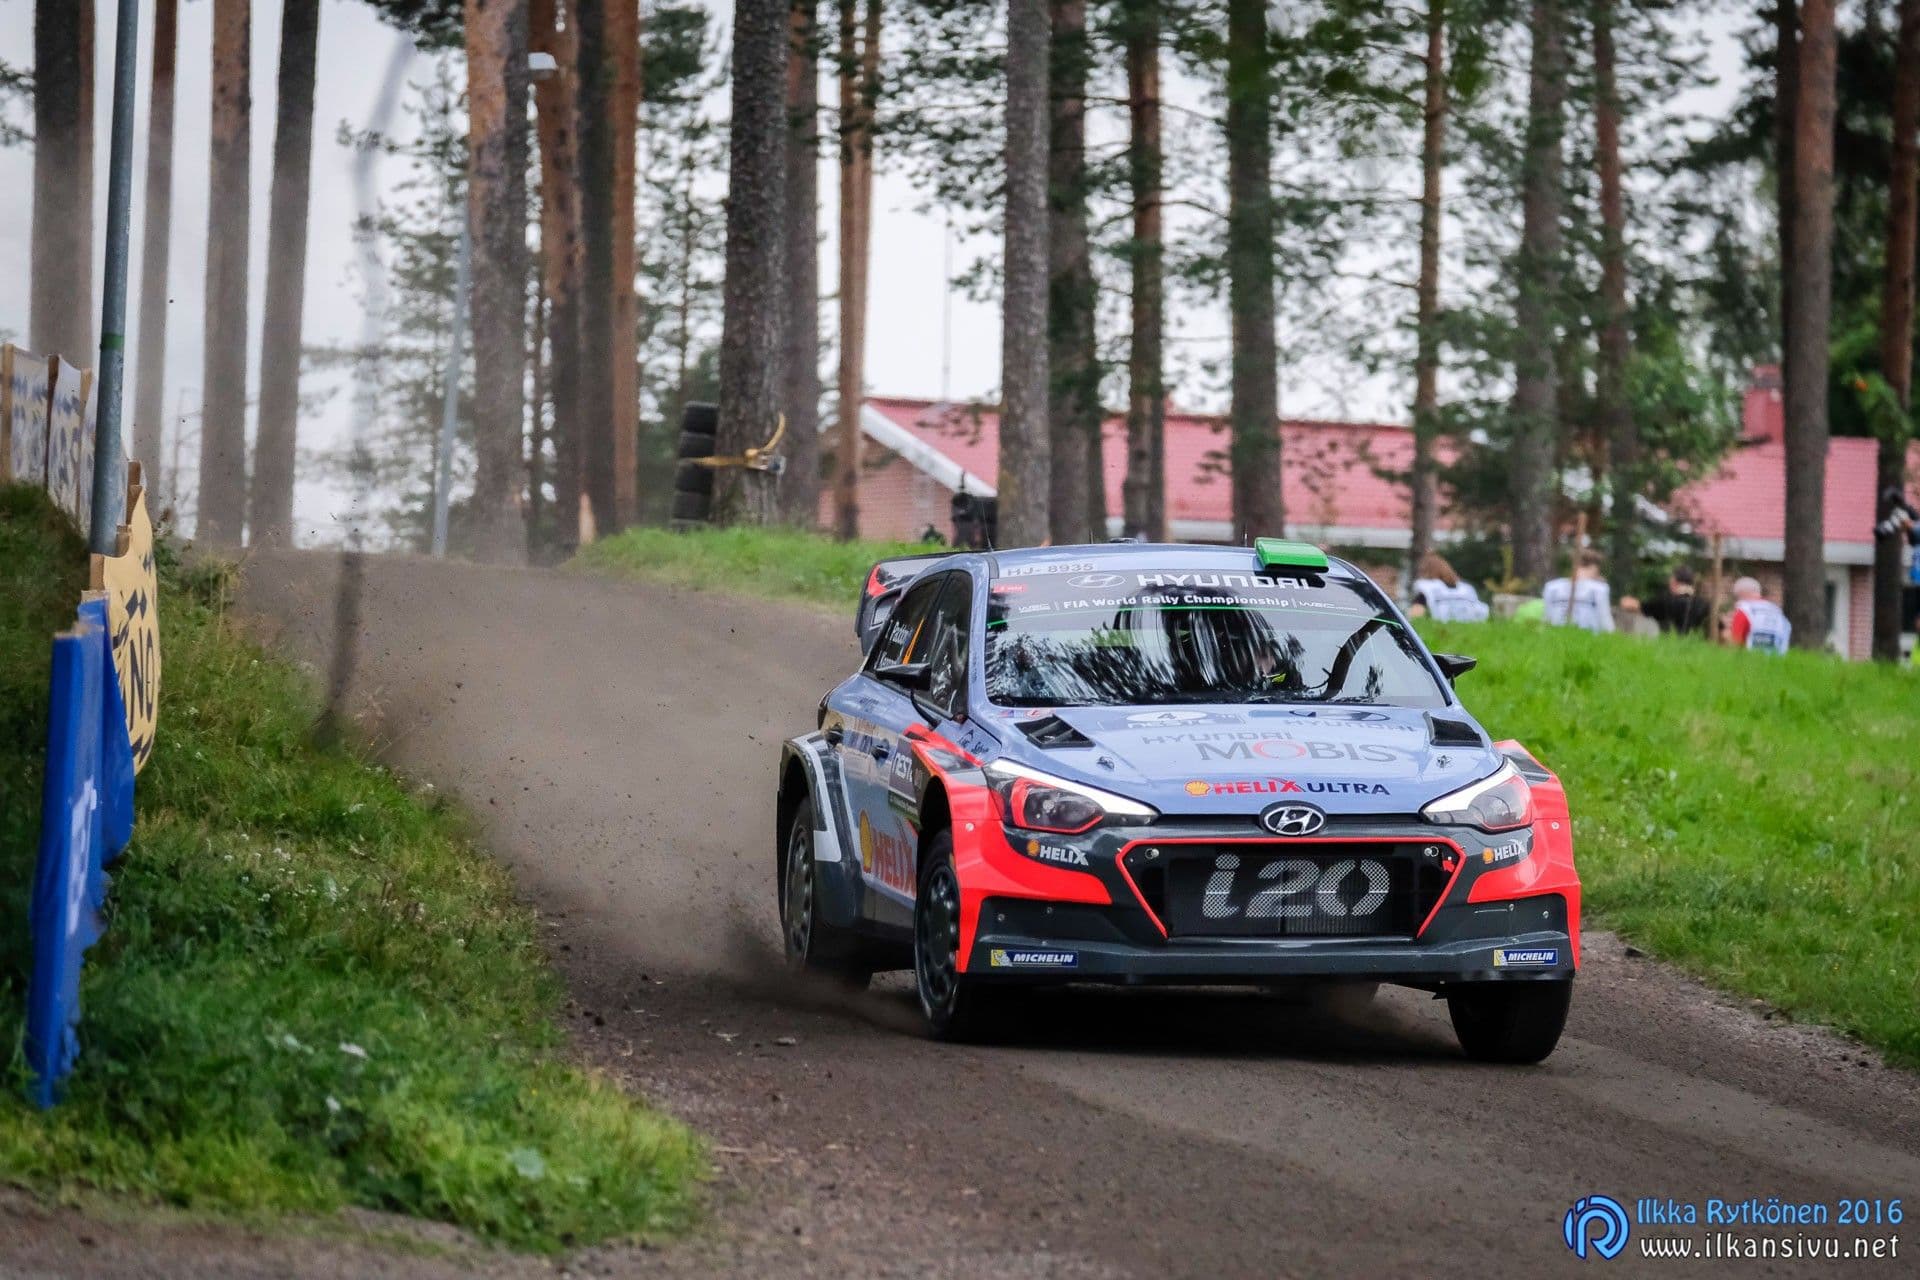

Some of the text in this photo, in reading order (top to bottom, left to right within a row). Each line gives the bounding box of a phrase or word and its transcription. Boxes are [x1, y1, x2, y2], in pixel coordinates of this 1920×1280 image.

[1137, 574, 1310, 590] HYUNDAI
[1063, 595, 1289, 610] FIA World Rally Championship
[1142, 732, 1293, 745] HYUNDAI
[1195, 739, 1397, 763] MOBIS
[1214, 776, 1391, 796] HELIX ULTRA
[1039, 844, 1089, 866] HELIX
[1494, 839, 1525, 861] HELIX
[1202, 852, 1391, 918] i20
[1013, 952, 1075, 964] MICHELIN
[1508, 951, 1555, 962] MICHELIN
